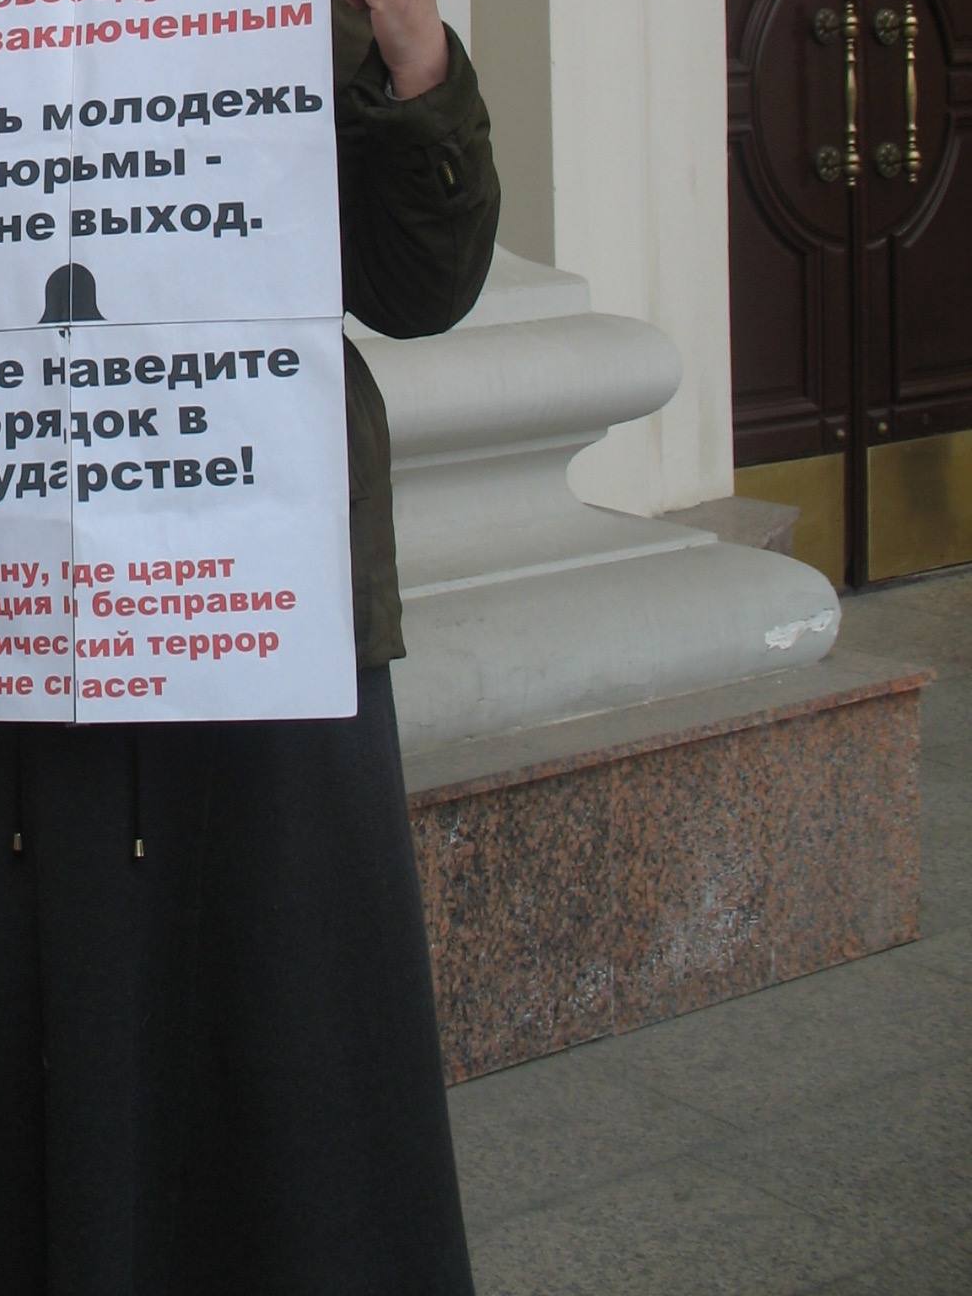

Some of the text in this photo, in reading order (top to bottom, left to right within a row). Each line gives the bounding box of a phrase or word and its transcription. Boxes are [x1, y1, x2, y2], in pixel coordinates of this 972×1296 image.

[41, 84, 324, 132] молодежь
[70, 200, 264, 239] выход.
[41, 346, 301, 391] наведите
[178, 405, 209, 436] в
[61, 559, 116, 589] где
[127, 557, 235, 587] царят
[62, 594, 79, 619] и
[91, 589, 297, 621] бесправие
[147, 631, 280, 661] террор
[43, 674, 167, 700] спасет
